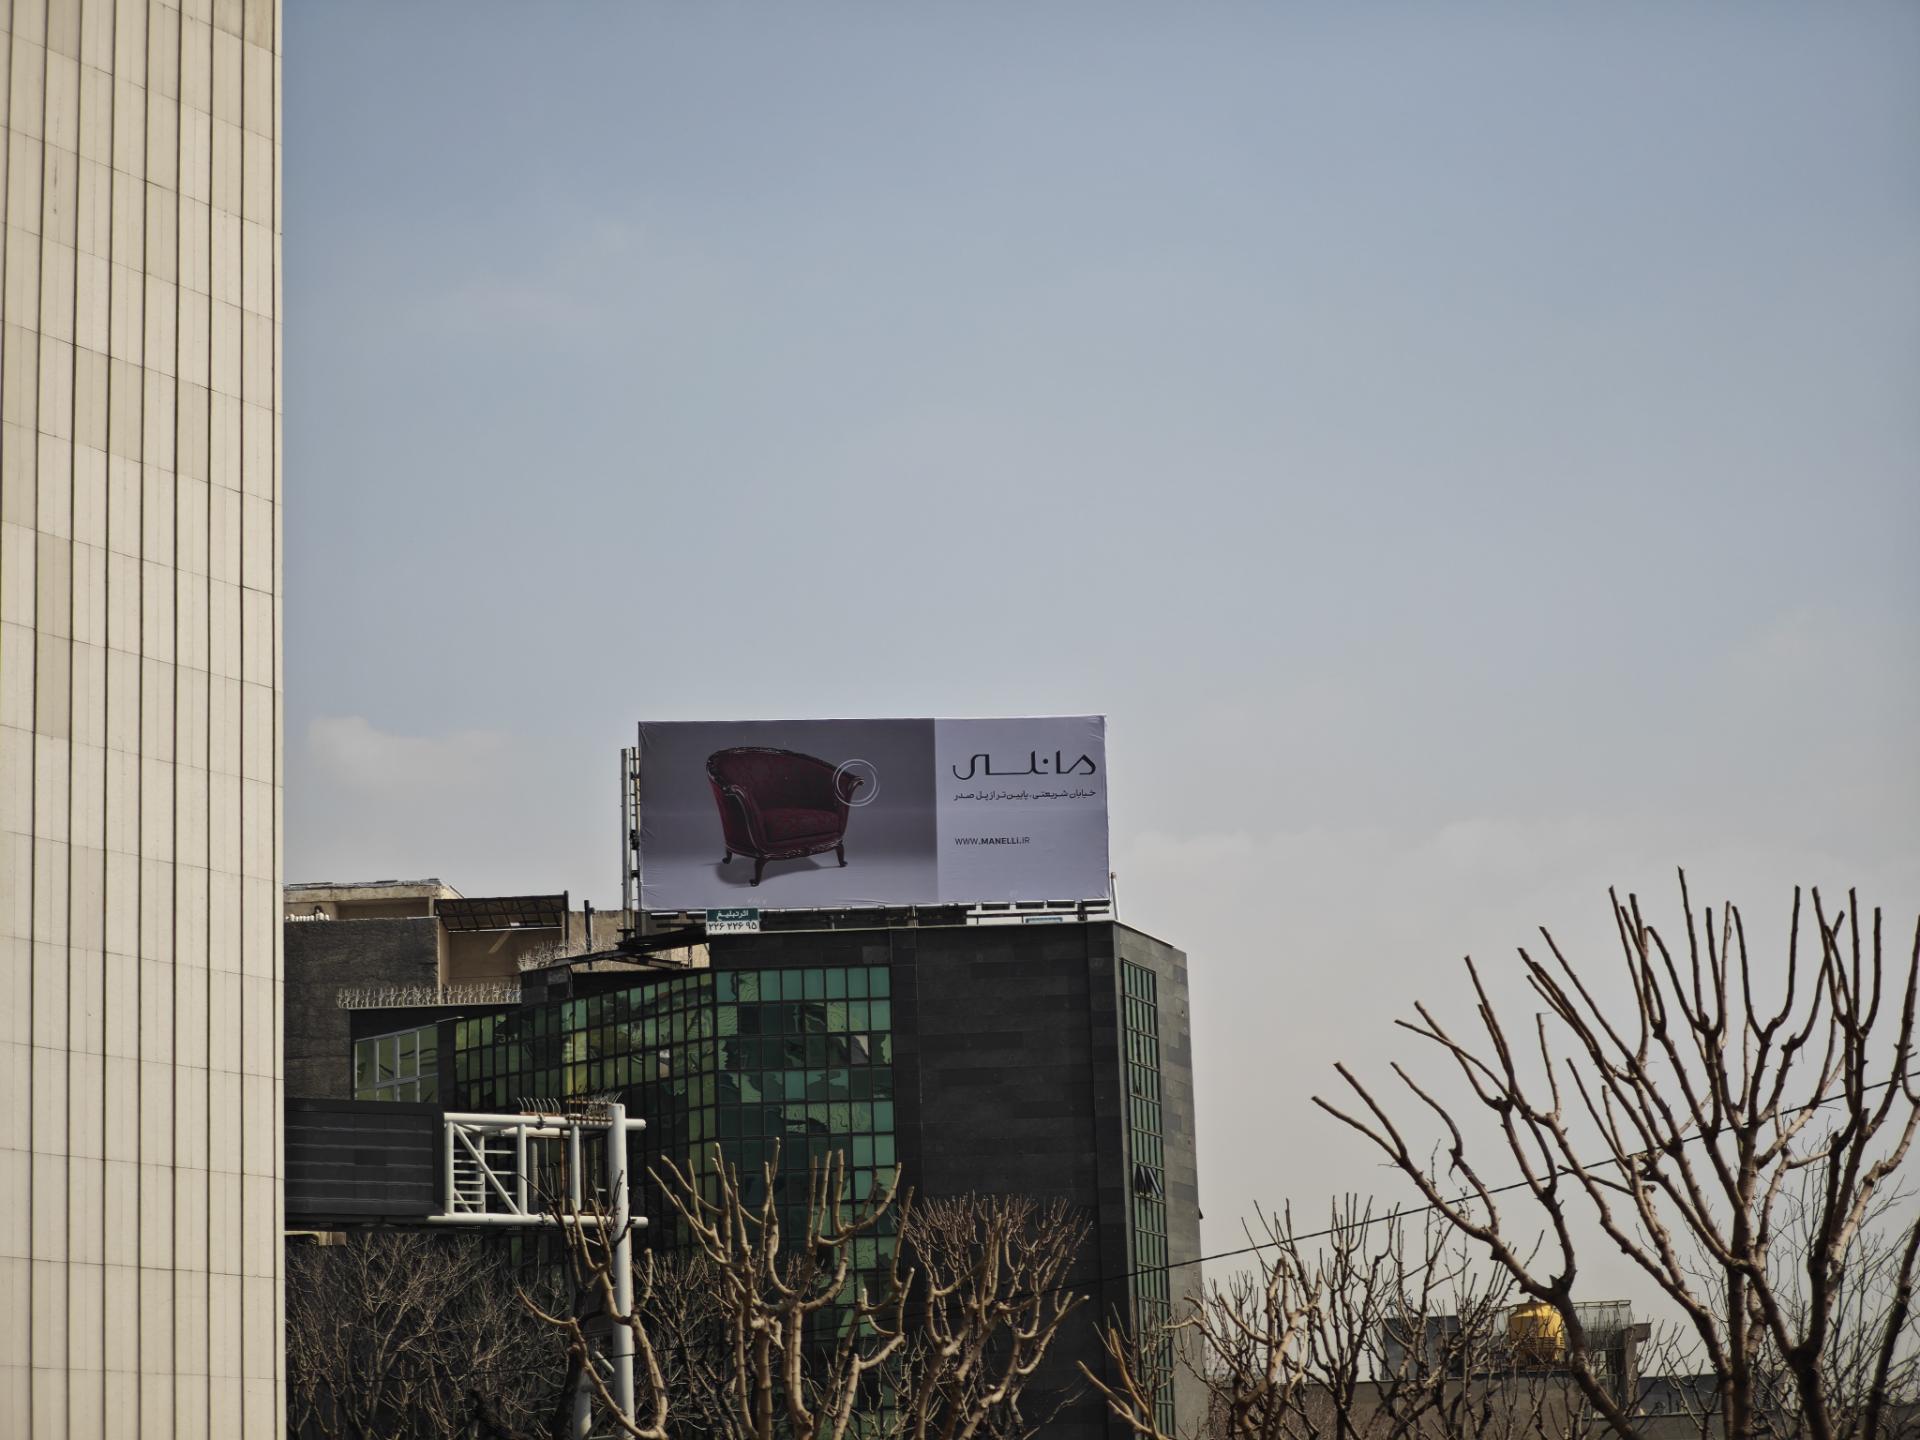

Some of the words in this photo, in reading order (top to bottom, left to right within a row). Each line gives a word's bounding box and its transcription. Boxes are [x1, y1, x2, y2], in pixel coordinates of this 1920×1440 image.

[952, 750, 1097, 780] مانلی
[953, 791, 975, 802] صدر
[1069, 788, 1097, 799] خیابان
